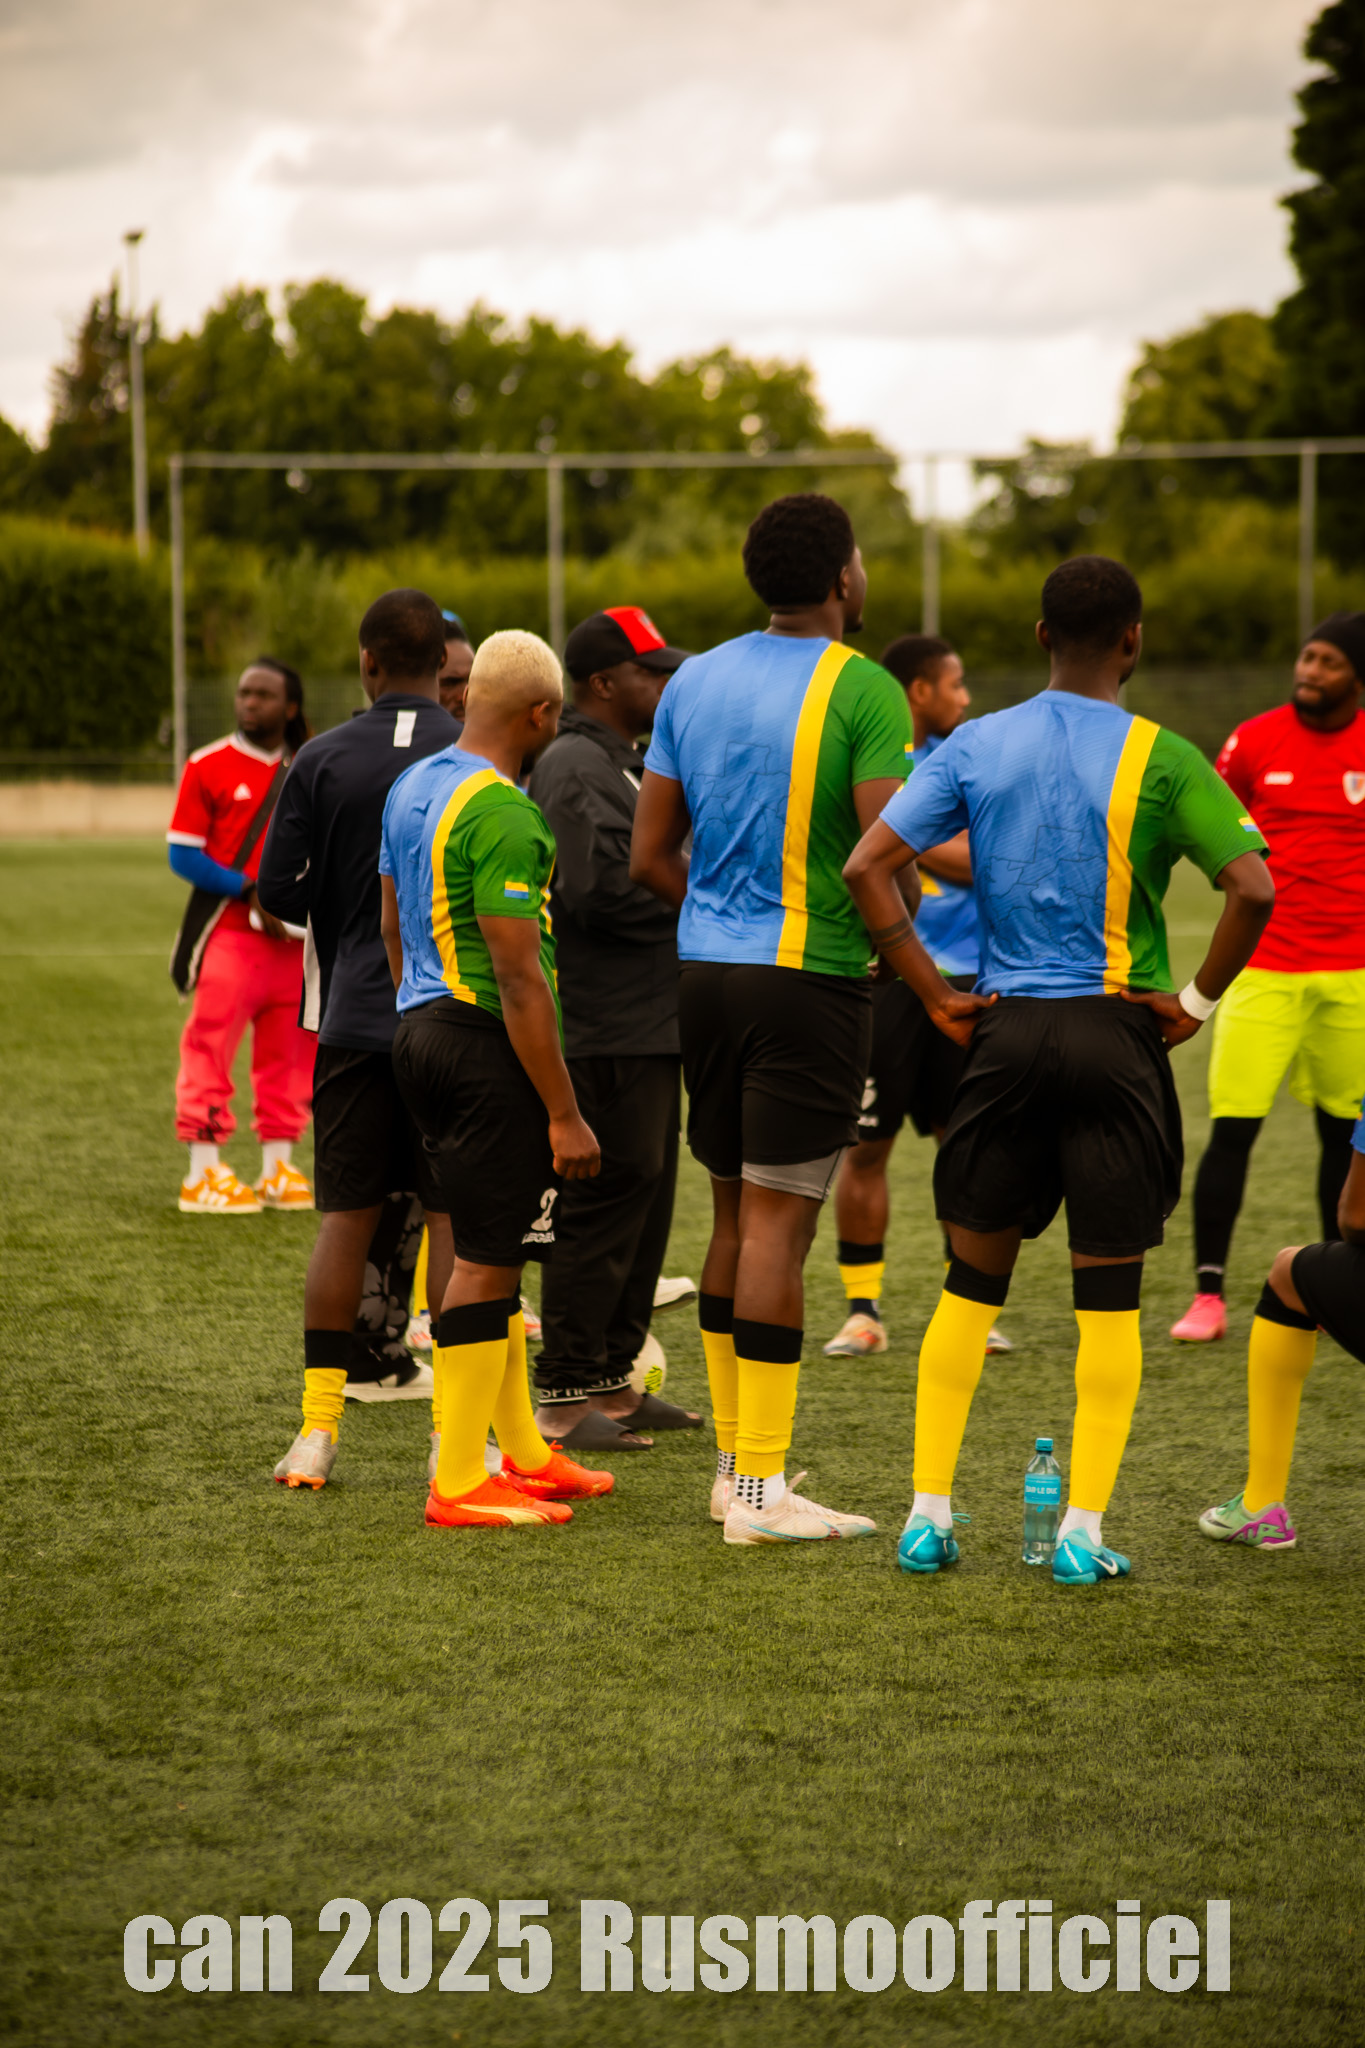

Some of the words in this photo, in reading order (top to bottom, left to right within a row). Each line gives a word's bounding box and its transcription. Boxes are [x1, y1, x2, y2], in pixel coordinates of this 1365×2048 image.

[531, 1187, 558, 1231] 2
[521, 1230, 555, 1245] LEGE
[1037, 1487, 1045, 1495] LE
